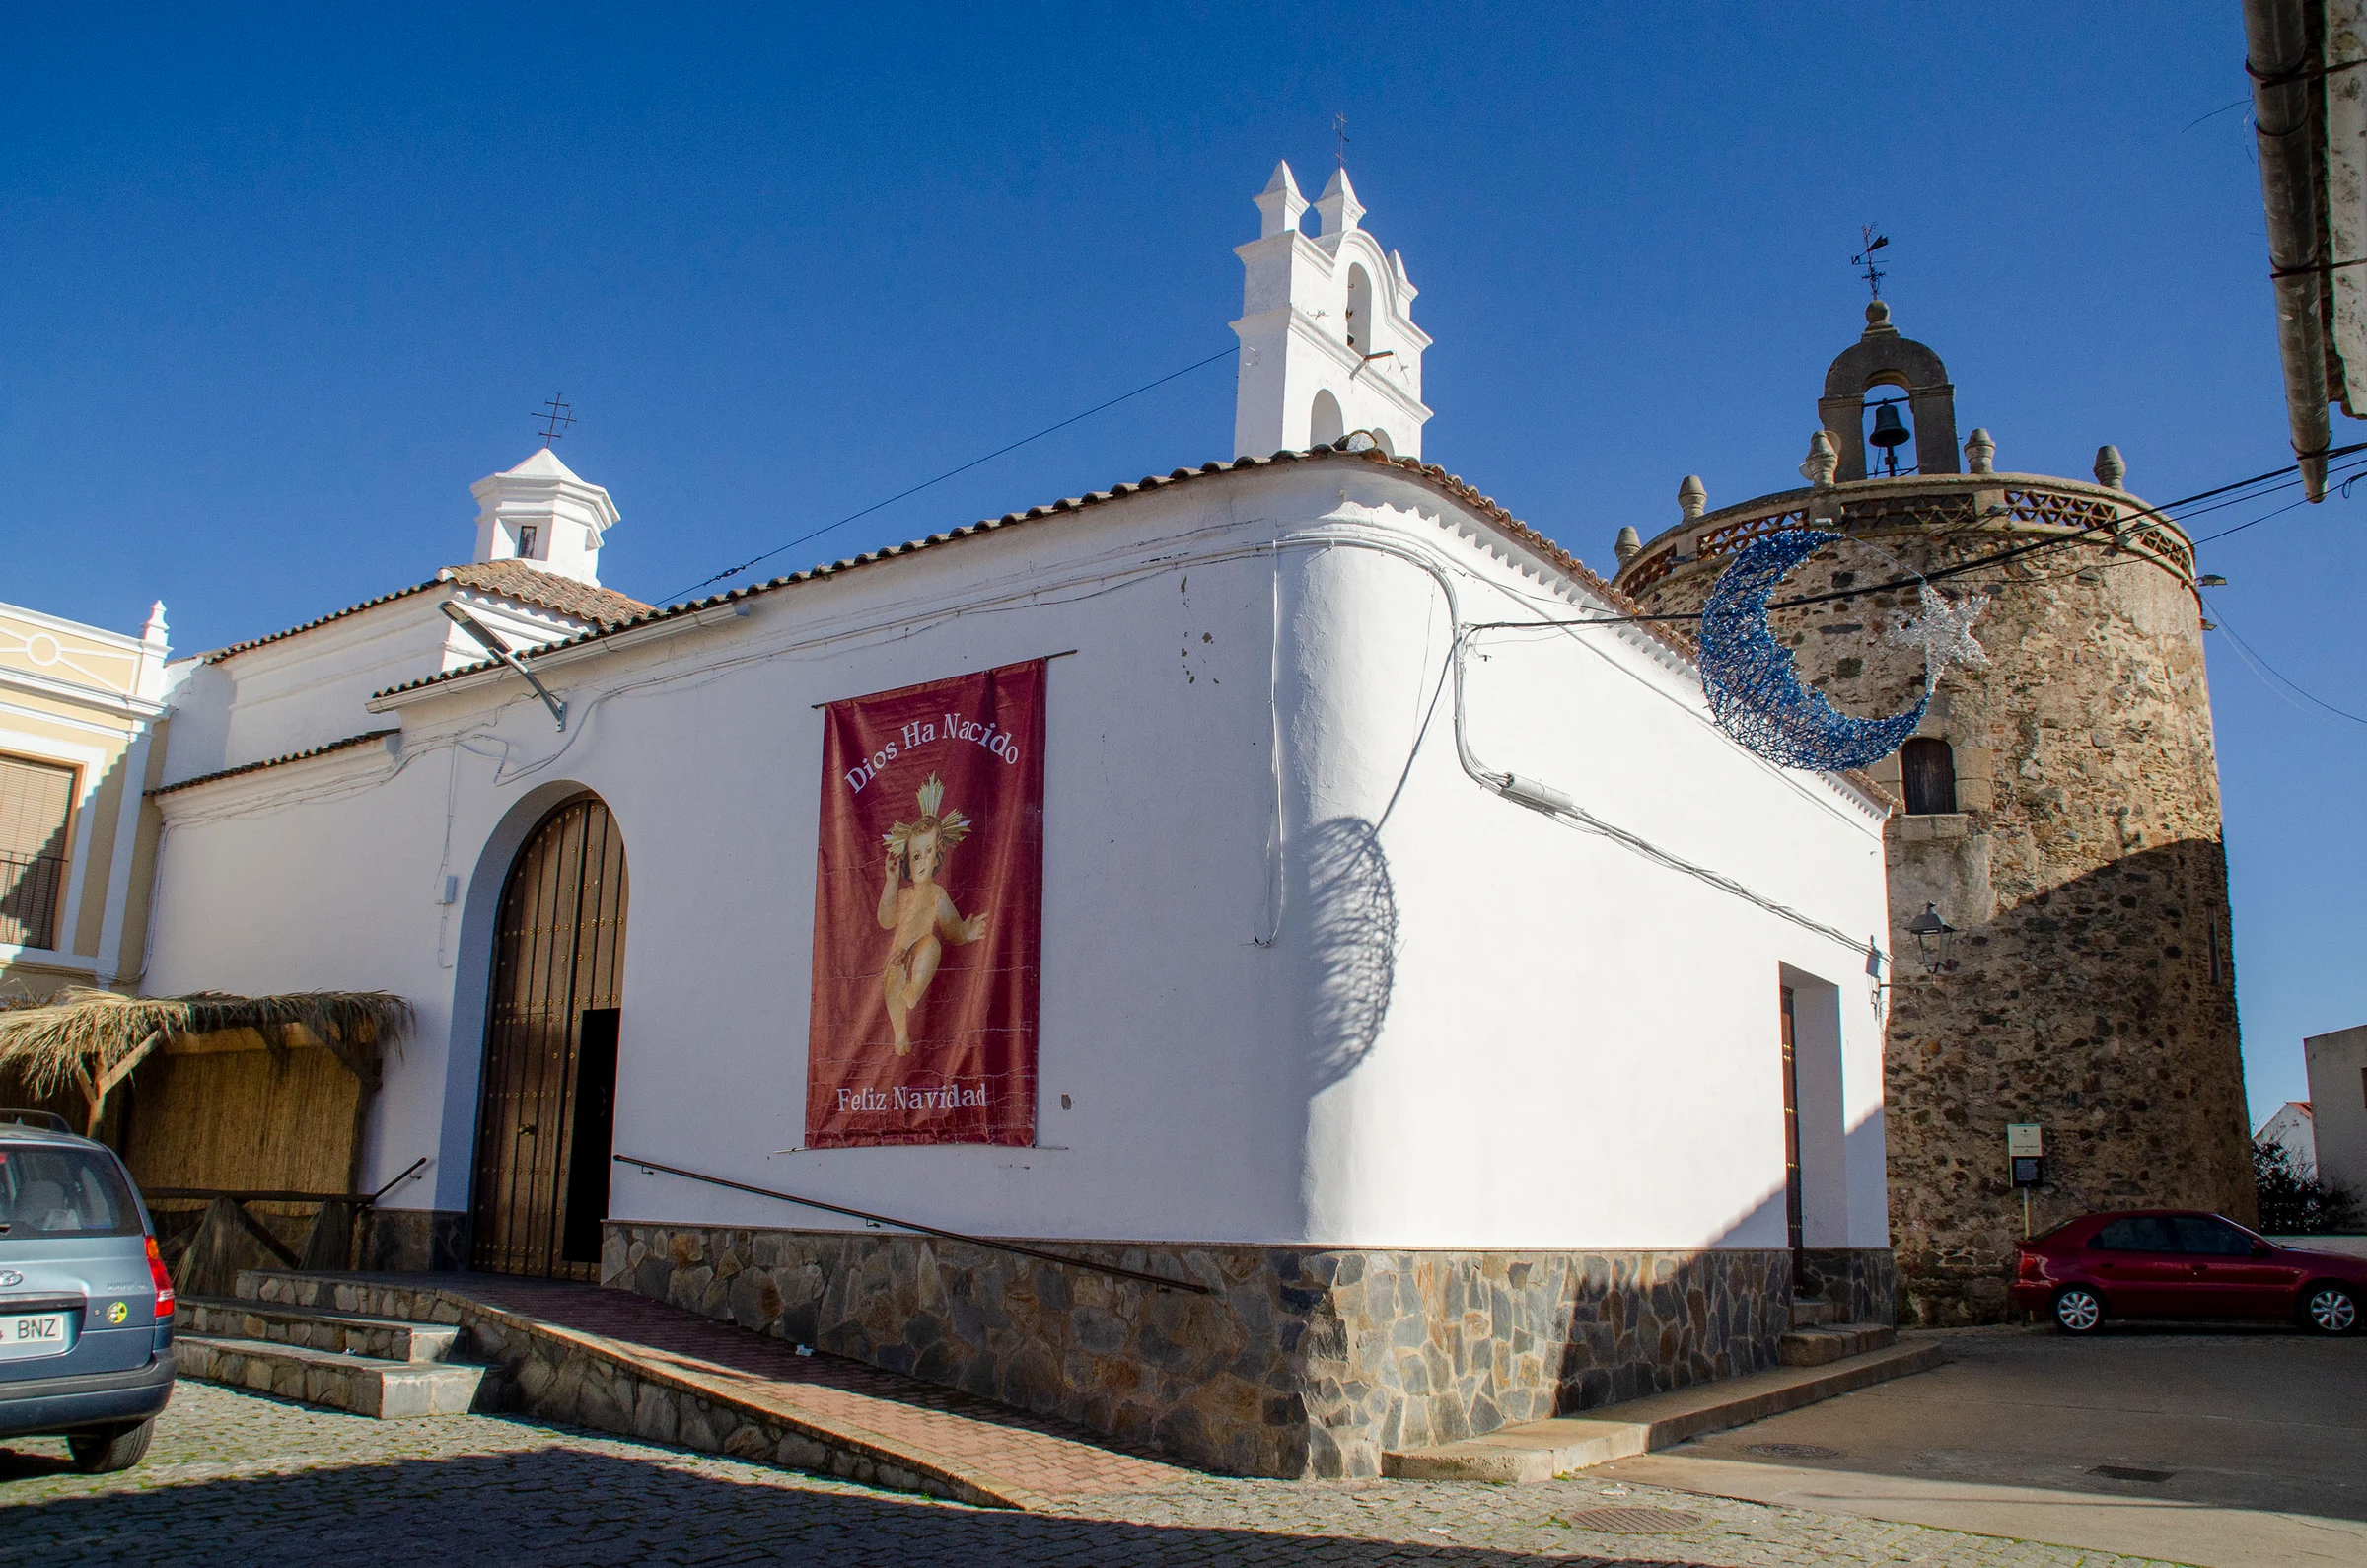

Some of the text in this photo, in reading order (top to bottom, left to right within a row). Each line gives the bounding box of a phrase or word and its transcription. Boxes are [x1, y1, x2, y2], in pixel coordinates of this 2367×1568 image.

[844, 713, 1019, 794] Dios Ha Nacido
[836, 1083, 987, 1111] Feliz Navidad
[18, 1319, 56, 1339] BNZ
